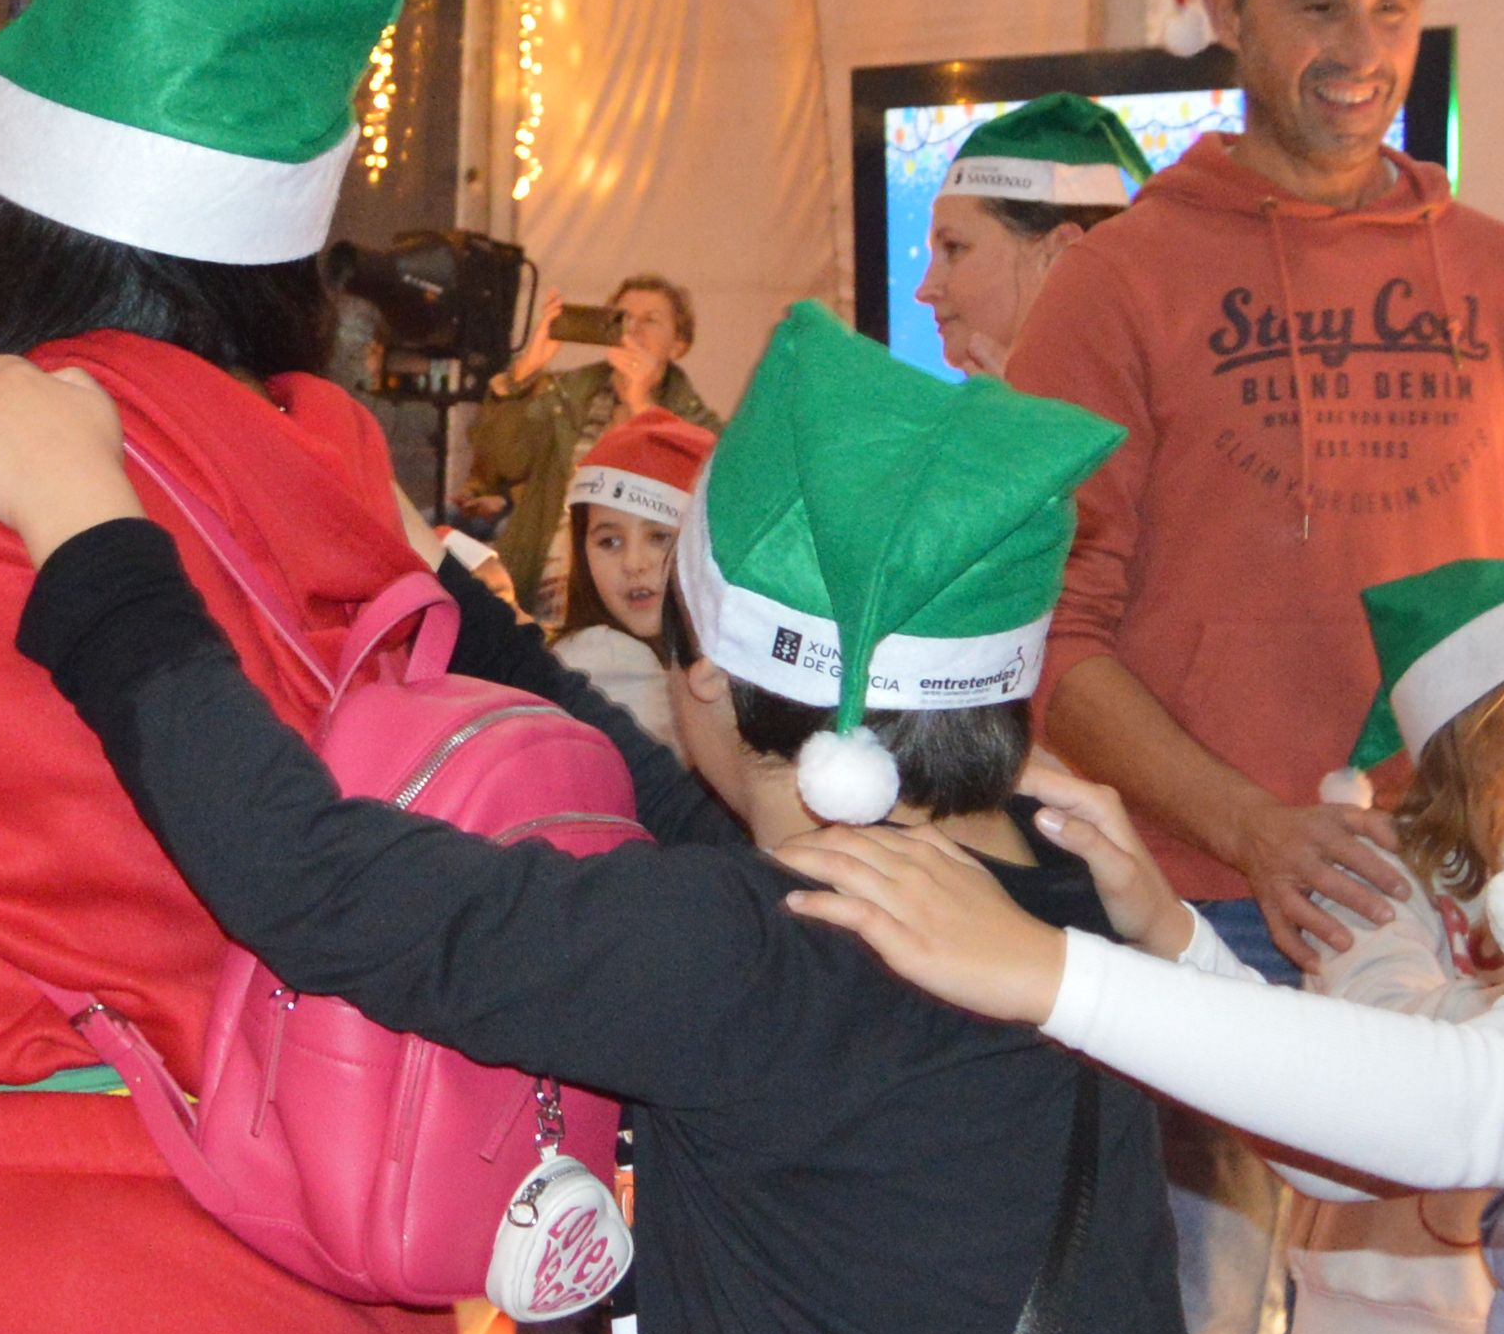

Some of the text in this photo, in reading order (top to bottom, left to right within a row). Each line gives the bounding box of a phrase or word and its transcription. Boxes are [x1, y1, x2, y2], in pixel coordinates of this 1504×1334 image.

[1209, 286, 1353, 367] Stay
[1375, 370, 1472, 400] DENIM
[807, 640, 844, 662] XUN
[803, 656, 900, 693] DE GCIA
[919, 668, 1017, 690] entretendas
